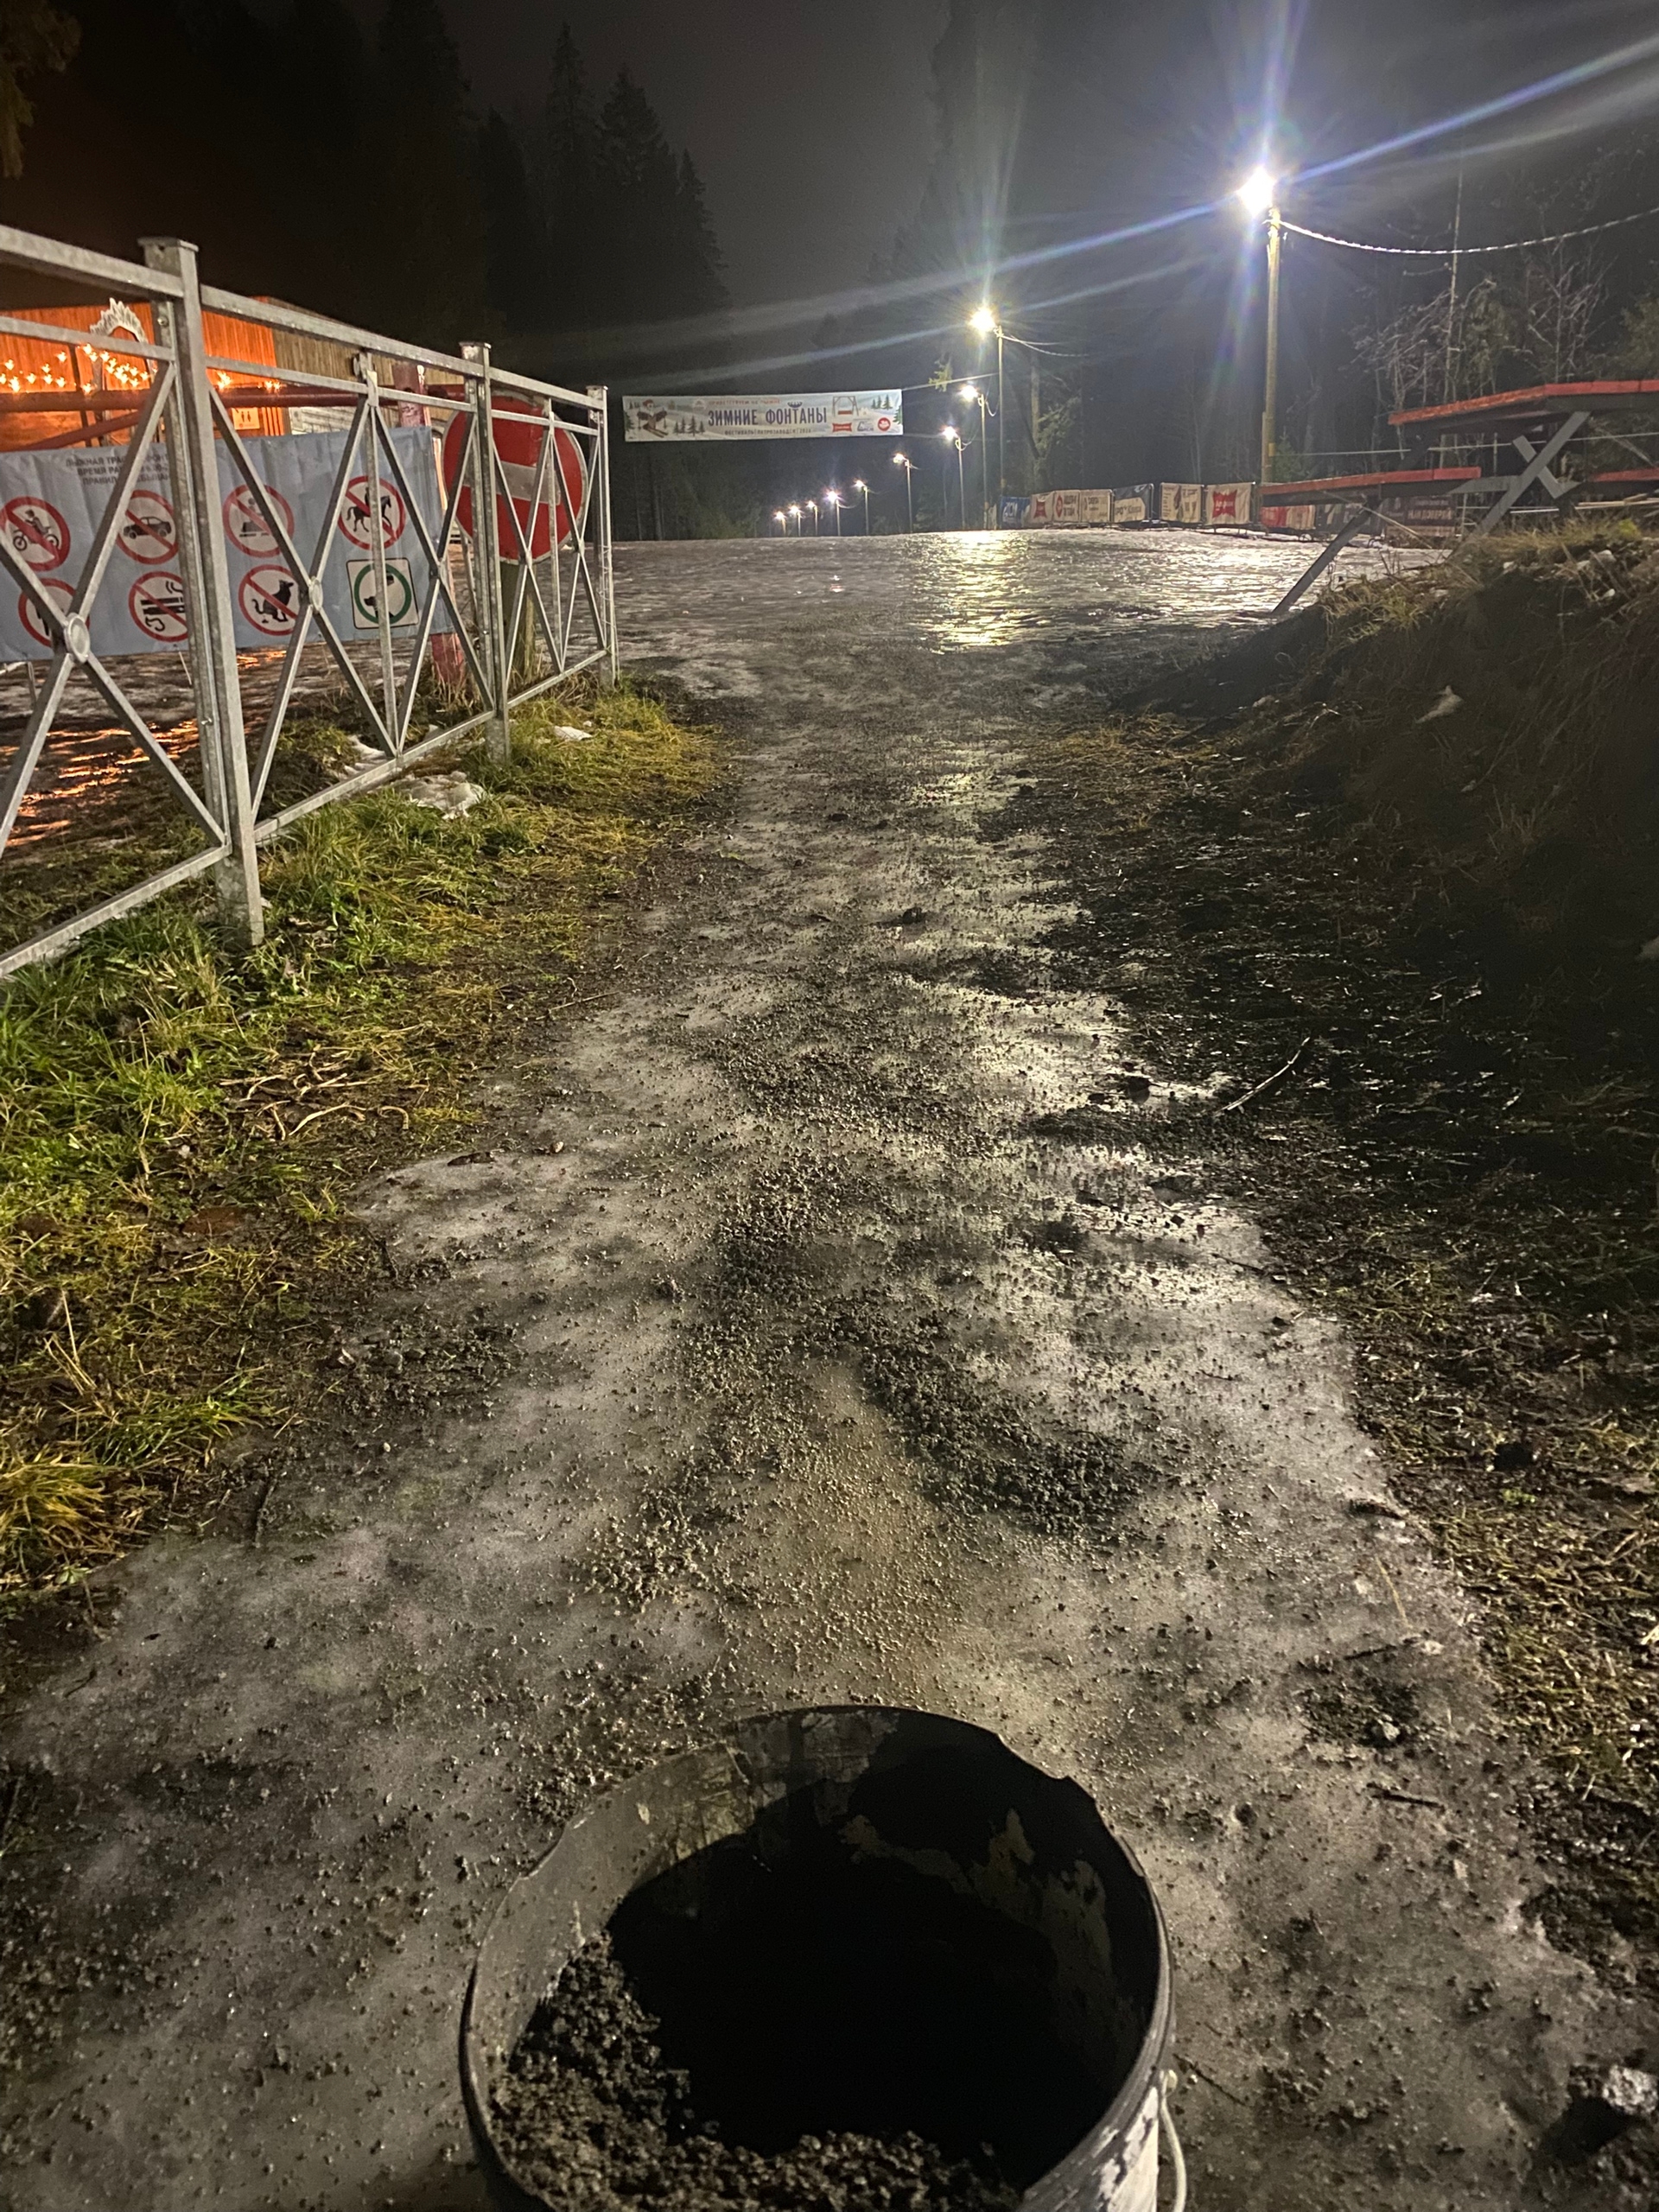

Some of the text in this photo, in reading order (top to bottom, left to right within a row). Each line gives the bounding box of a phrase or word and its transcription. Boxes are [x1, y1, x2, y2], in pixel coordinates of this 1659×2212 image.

[708, 407, 828, 427] ЗИМНИЕ ФОНТАНЫ
[77, 467, 106, 476] ВРЕМЯ
[82, 476, 118, 486] ПРАВИЛ
